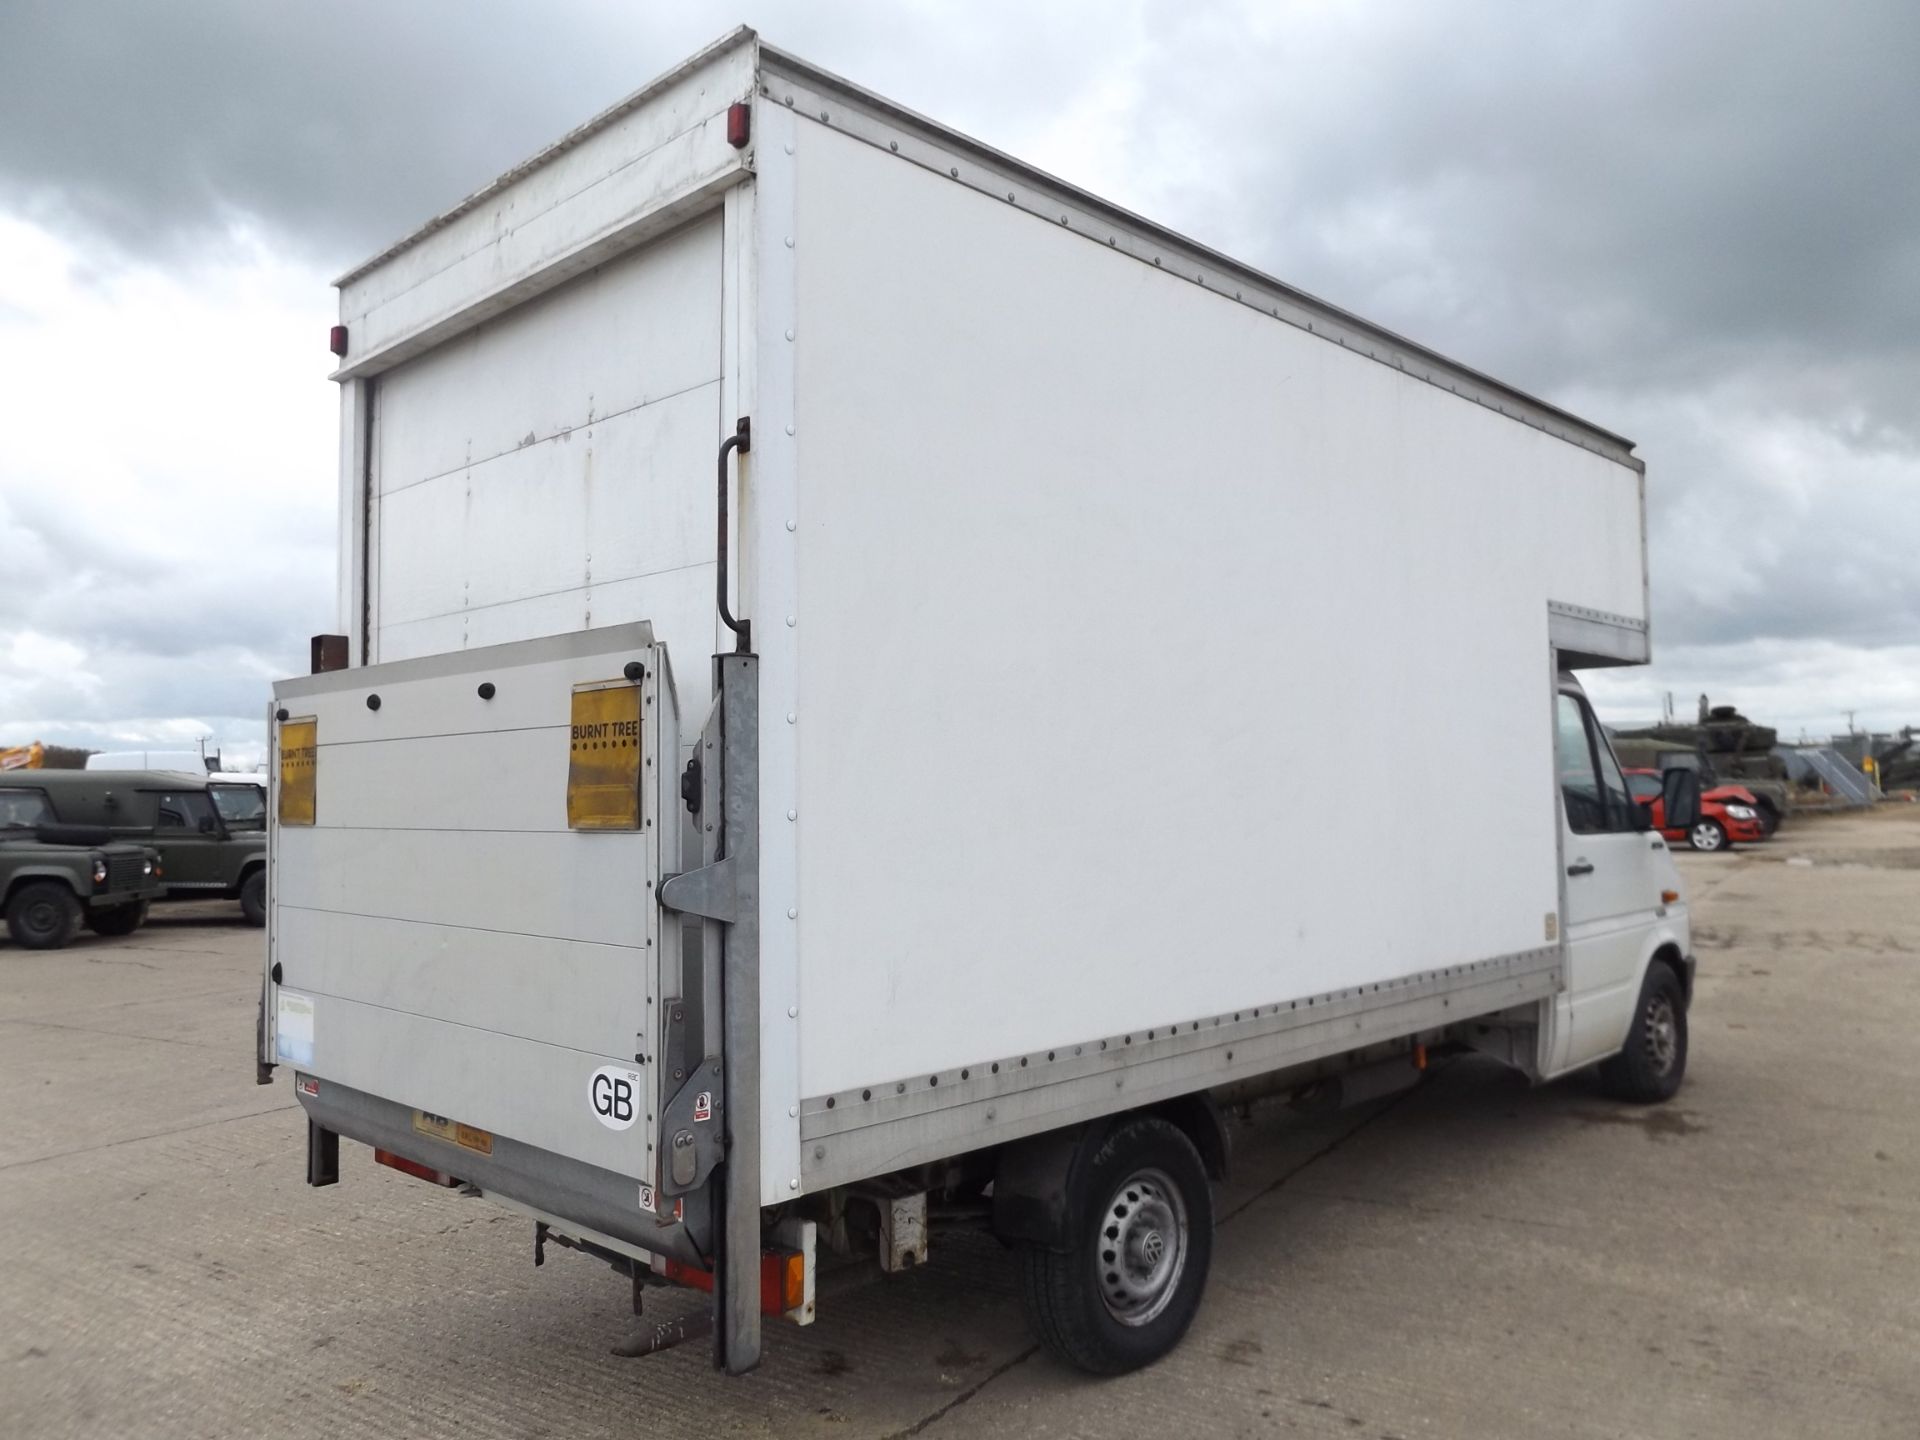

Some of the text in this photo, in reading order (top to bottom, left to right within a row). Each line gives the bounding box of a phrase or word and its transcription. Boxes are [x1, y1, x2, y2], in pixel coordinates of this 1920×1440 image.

[572, 720, 639, 740] BURNT TREE
[281, 746, 316, 760] BURNT TREE
[592, 1073, 633, 1122] GB
